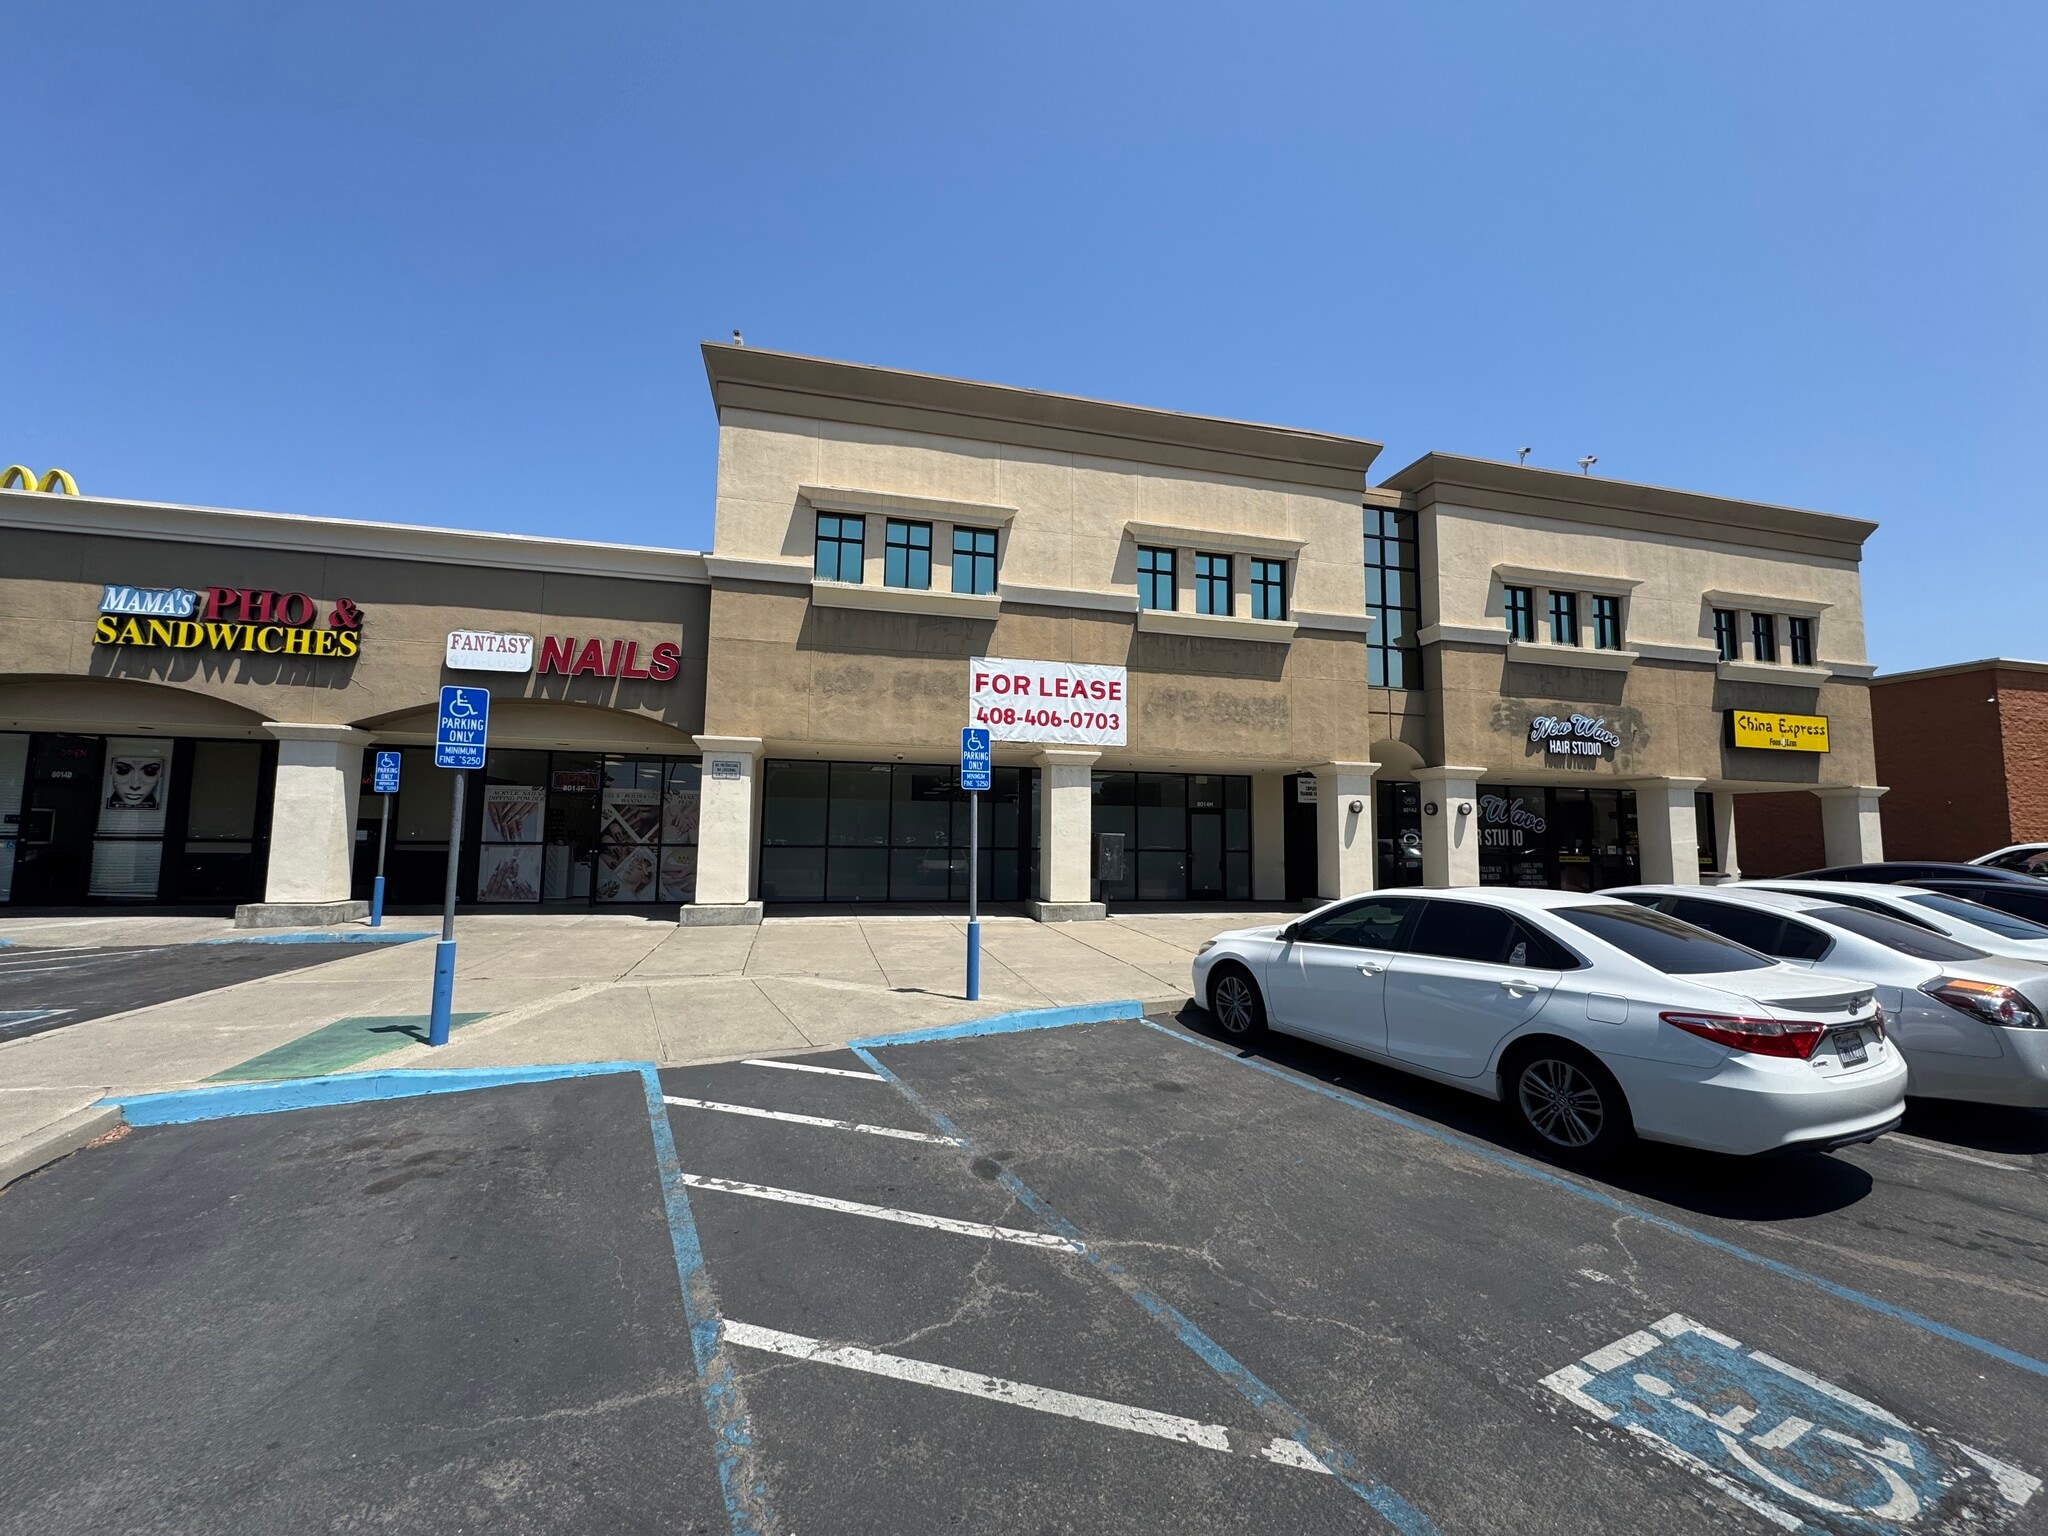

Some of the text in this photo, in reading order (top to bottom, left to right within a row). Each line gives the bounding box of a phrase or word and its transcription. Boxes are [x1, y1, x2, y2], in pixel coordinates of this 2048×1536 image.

[205, 587, 314, 626] PHO
[329, 597, 364, 628] &
[94, 616, 358, 657] SANDWICHES
[450, 633, 530, 654] FANTASY
[537, 635, 681, 681] NAILS
[975, 673, 1122, 701] FOR LEASE
[441, 717, 484, 731] PARKING
[976, 707, 1120, 730] 408-406-0703
[1738, 715, 1825, 738] China Express
[449, 730, 474, 743] ONLY
[1531, 713, 1620, 748] New Wave
[445, 746, 477, 755] MINIMUM
[964, 751, 989, 761] PARKING
[1549, 739, 1602, 756] HAIR STUDIO
[439, 755, 455, 764] FINE
[968, 761, 984, 770] ONLY
[1480, 795, 1546, 833] Wave
